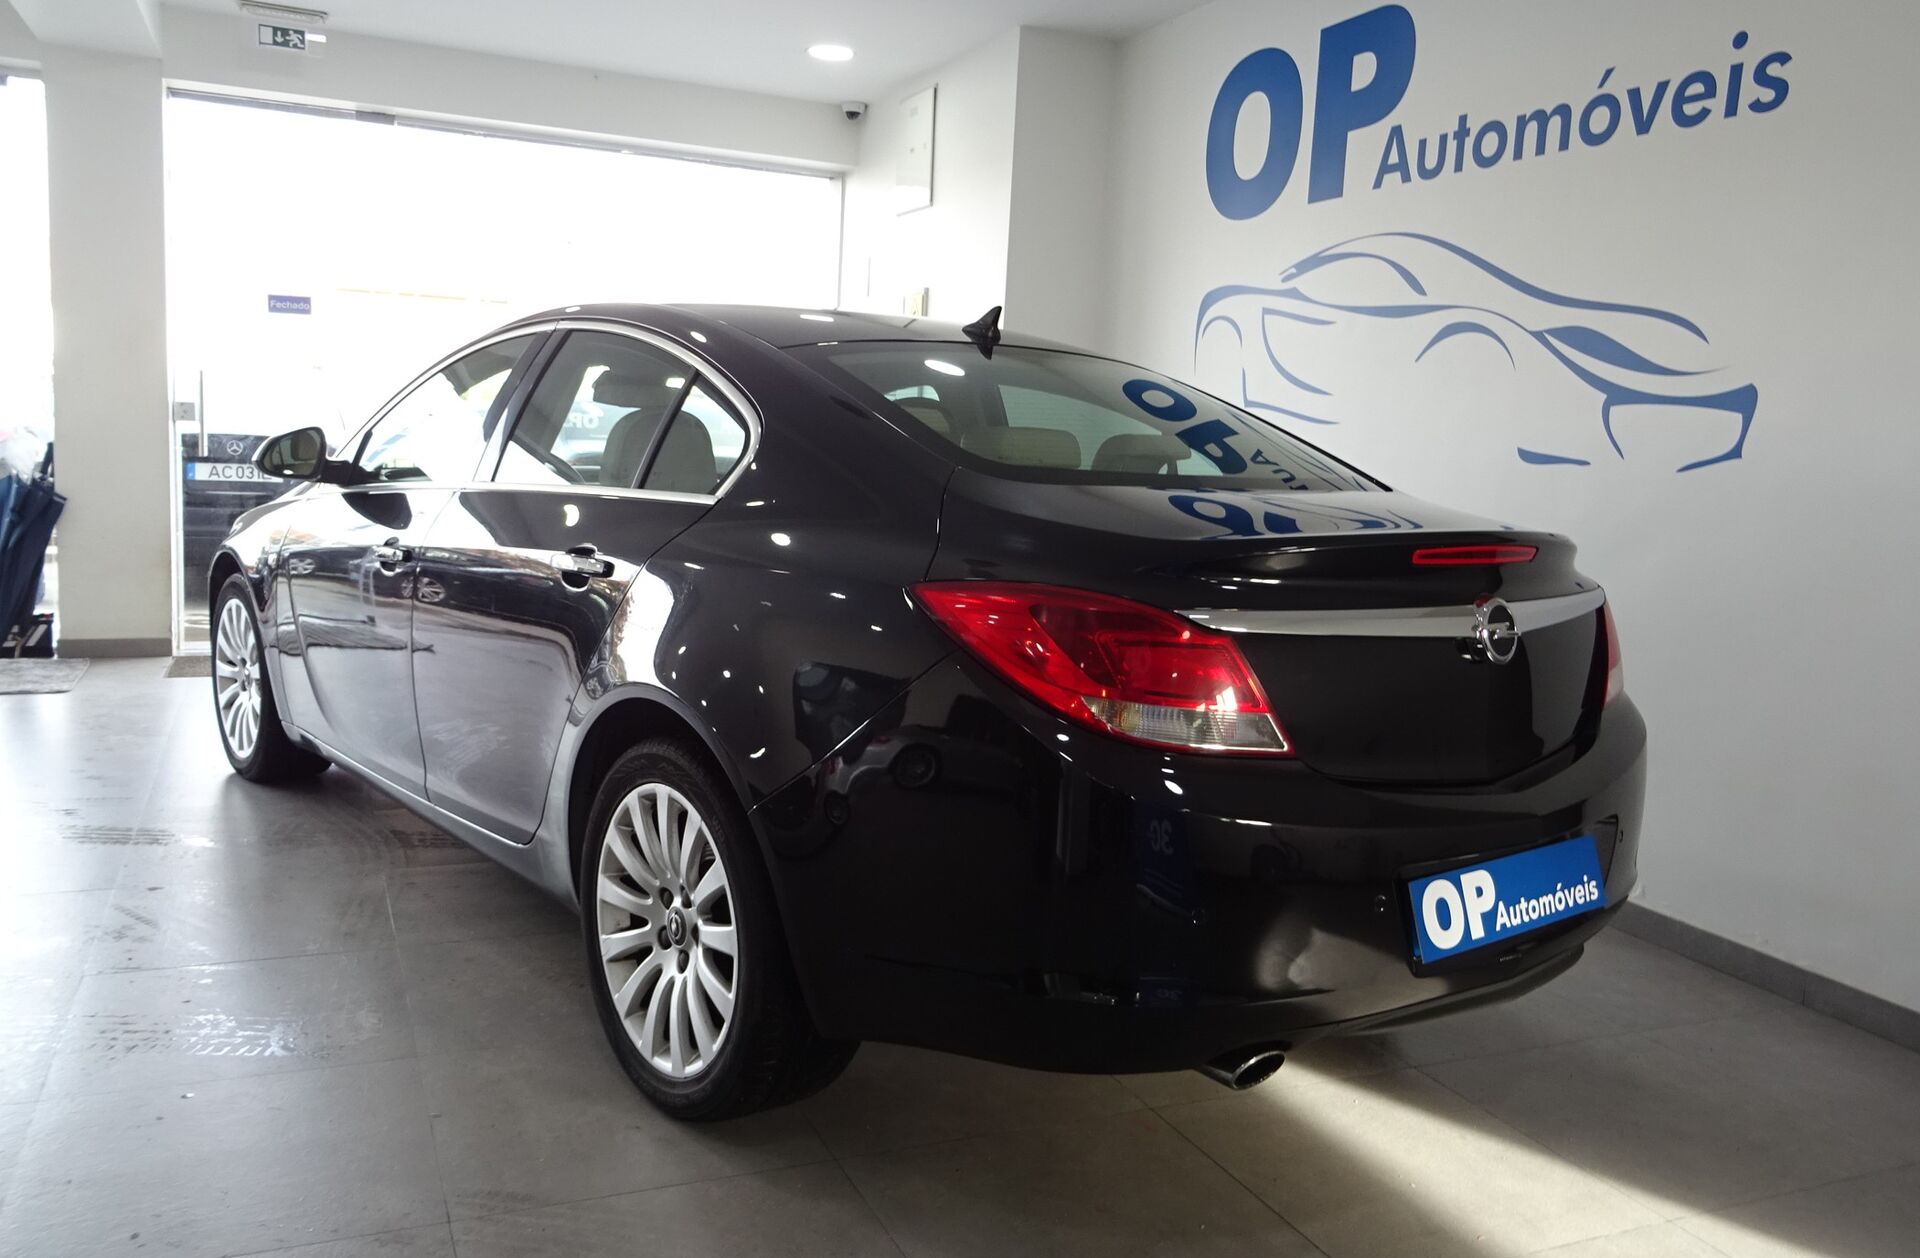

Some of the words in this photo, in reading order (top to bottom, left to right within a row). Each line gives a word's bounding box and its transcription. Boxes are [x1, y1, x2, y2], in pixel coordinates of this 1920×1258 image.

[1206, 4, 1416, 221] OP
[1372, 30, 1793, 190] Automóveis
[270, 300, 310, 310] Fechado
[1422, 869, 1496, 950] OP
[1495, 875, 1599, 932] Automóveis
